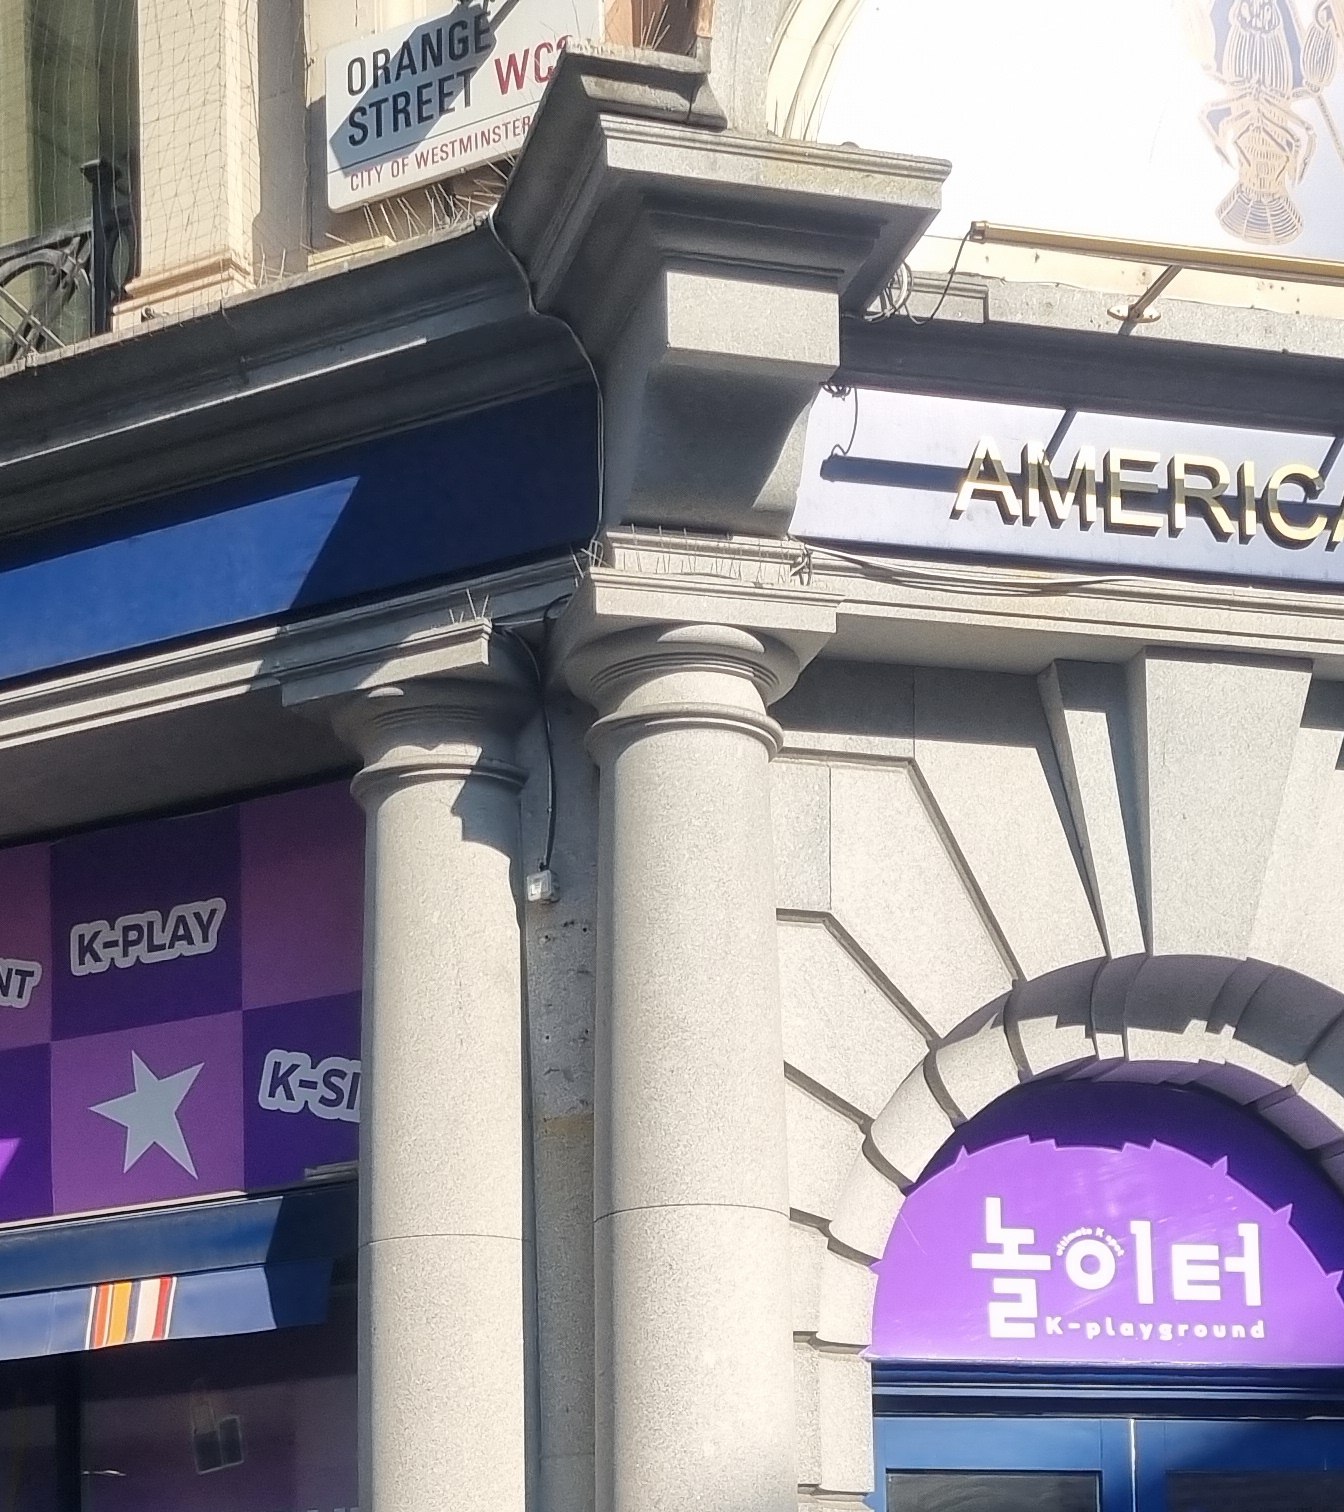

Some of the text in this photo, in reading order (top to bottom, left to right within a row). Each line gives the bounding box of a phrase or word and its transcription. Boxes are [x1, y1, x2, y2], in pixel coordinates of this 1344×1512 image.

[347, 11, 493, 96] ORANGE
[494, 35, 573, 95] WC
[348, 67, 478, 147] STREET
[350, 115, 532, 191] CITY OF WESTMINSTER
[77, 909, 221, 966] K-PLAY
[971, 1196, 1263, 1339] 놀이터
[1044, 1316, 1266, 1341] K-playground
